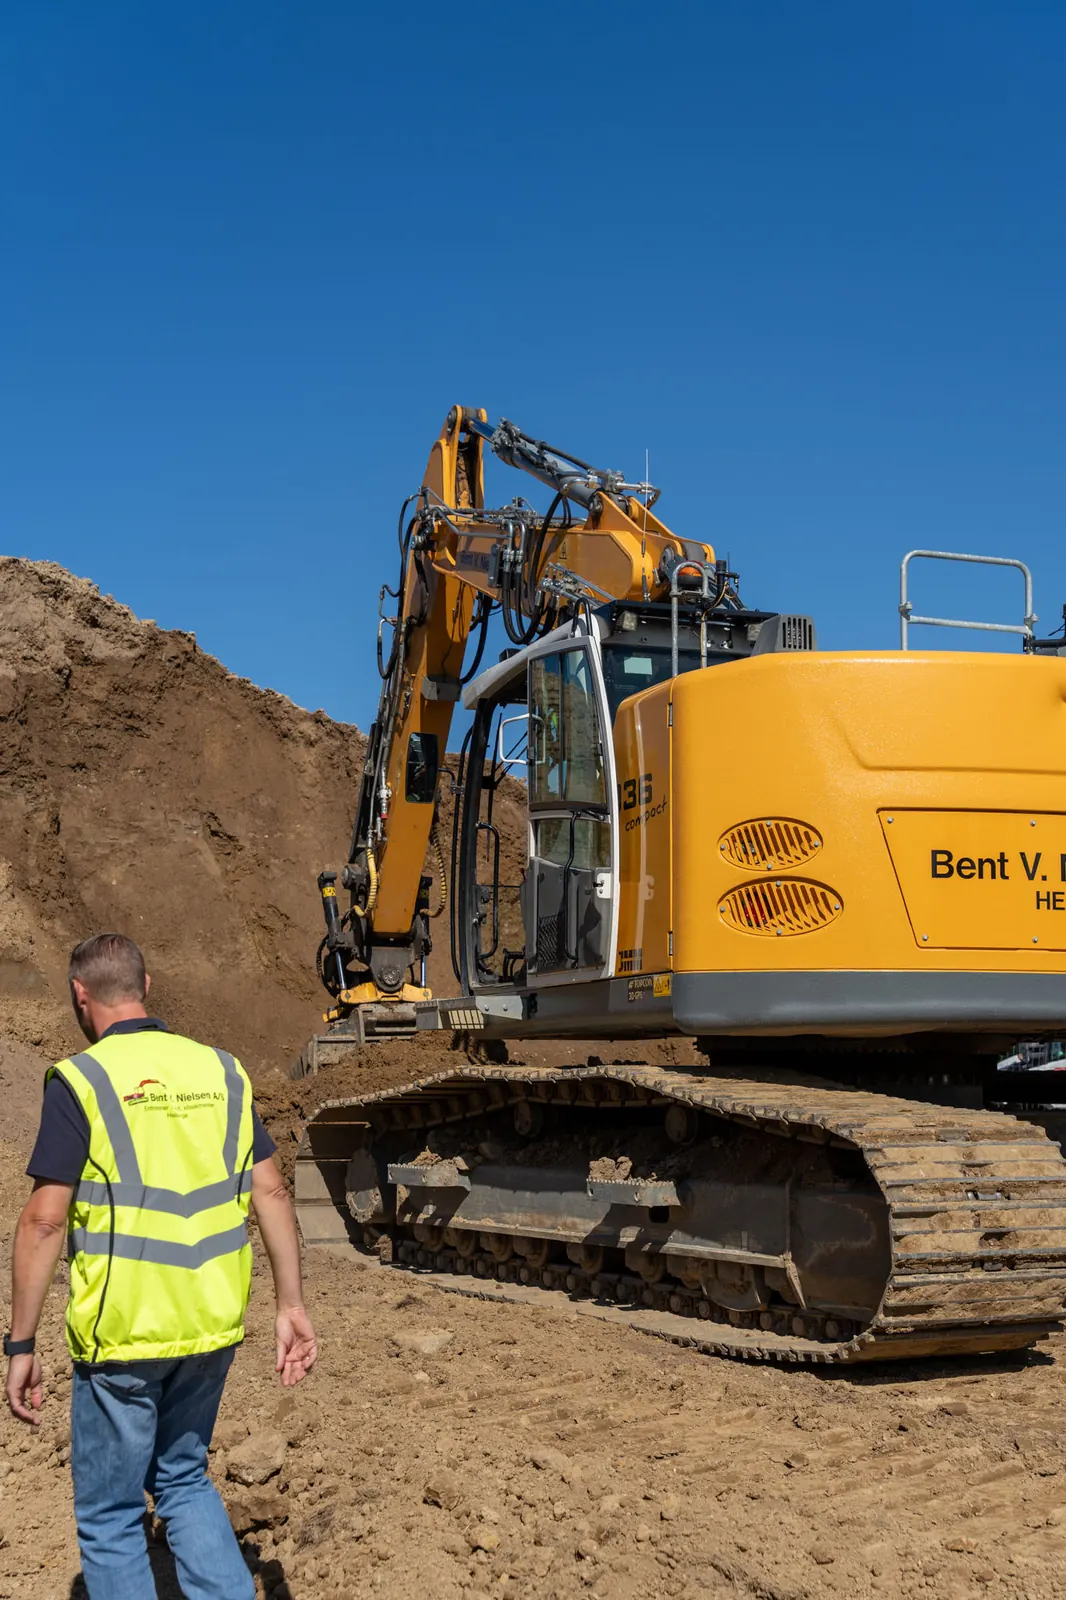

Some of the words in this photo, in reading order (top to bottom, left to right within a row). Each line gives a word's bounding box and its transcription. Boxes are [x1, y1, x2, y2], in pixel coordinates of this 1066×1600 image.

[624, 793, 667, 831] compact
[930, 849, 1009, 880] Bent
[1019, 852, 1048, 881] V.
[176, 1092, 211, 1102] Nielsen
